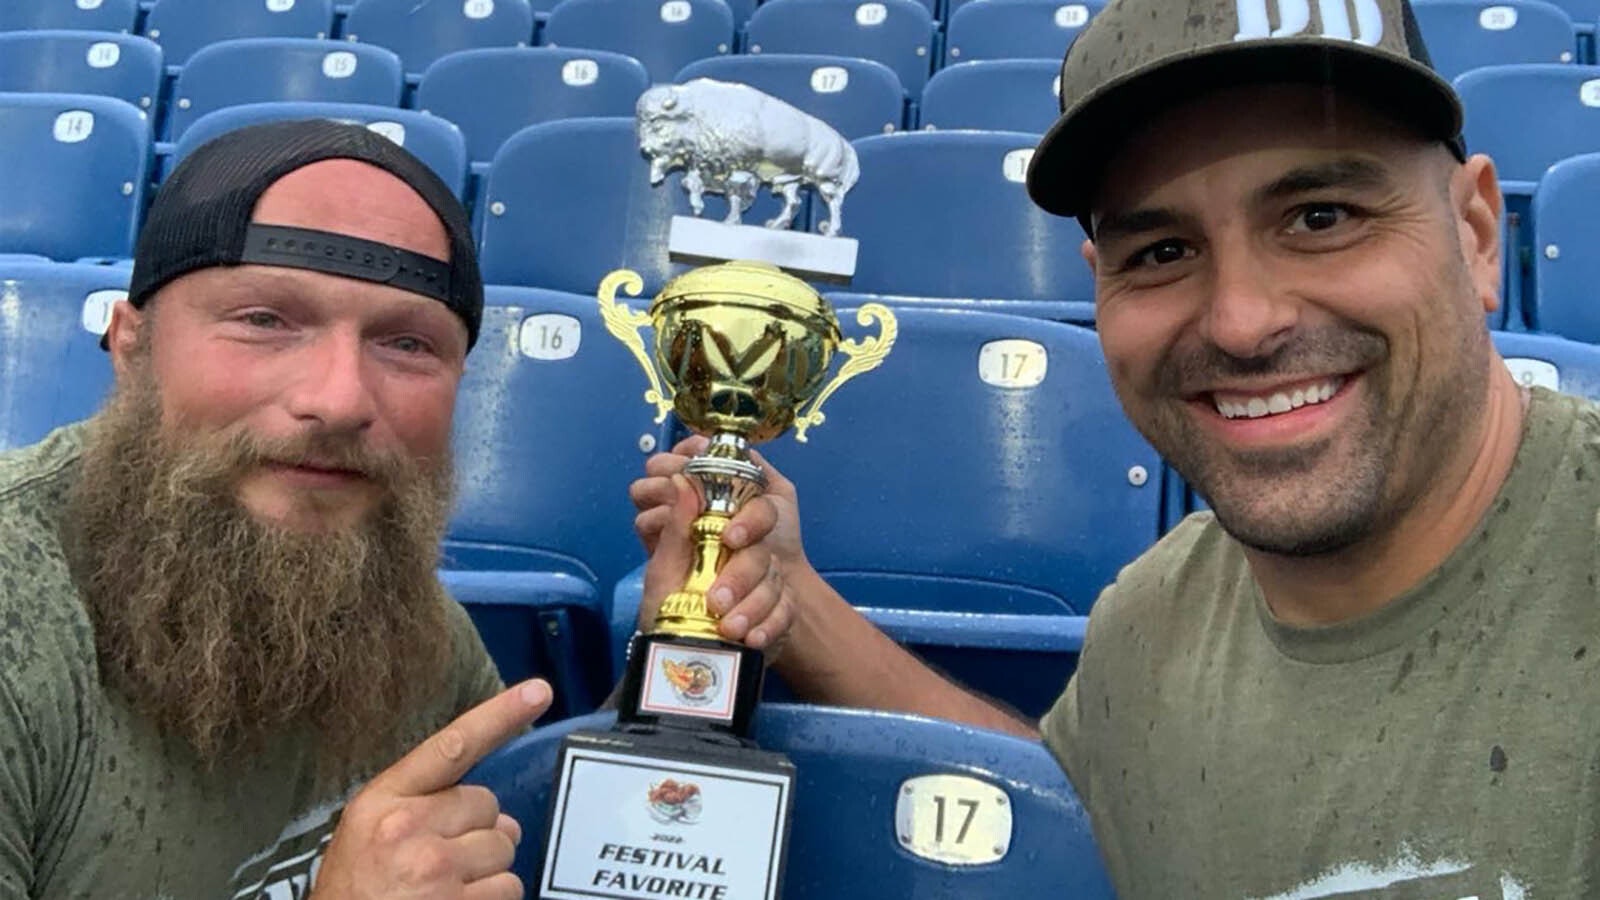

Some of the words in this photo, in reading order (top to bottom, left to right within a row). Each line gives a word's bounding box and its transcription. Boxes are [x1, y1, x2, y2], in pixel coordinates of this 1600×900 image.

[574, 65, 589, 81] 16
[822, 74, 836, 90] 17
[66, 117, 83, 136] 14
[539, 325, 563, 350] 16
[1000, 353, 1028, 379] 17
[932, 795, 979, 845] 17
[598, 843, 726, 875] FESTIVAL
[592, 869, 728, 900] FAVORITE
